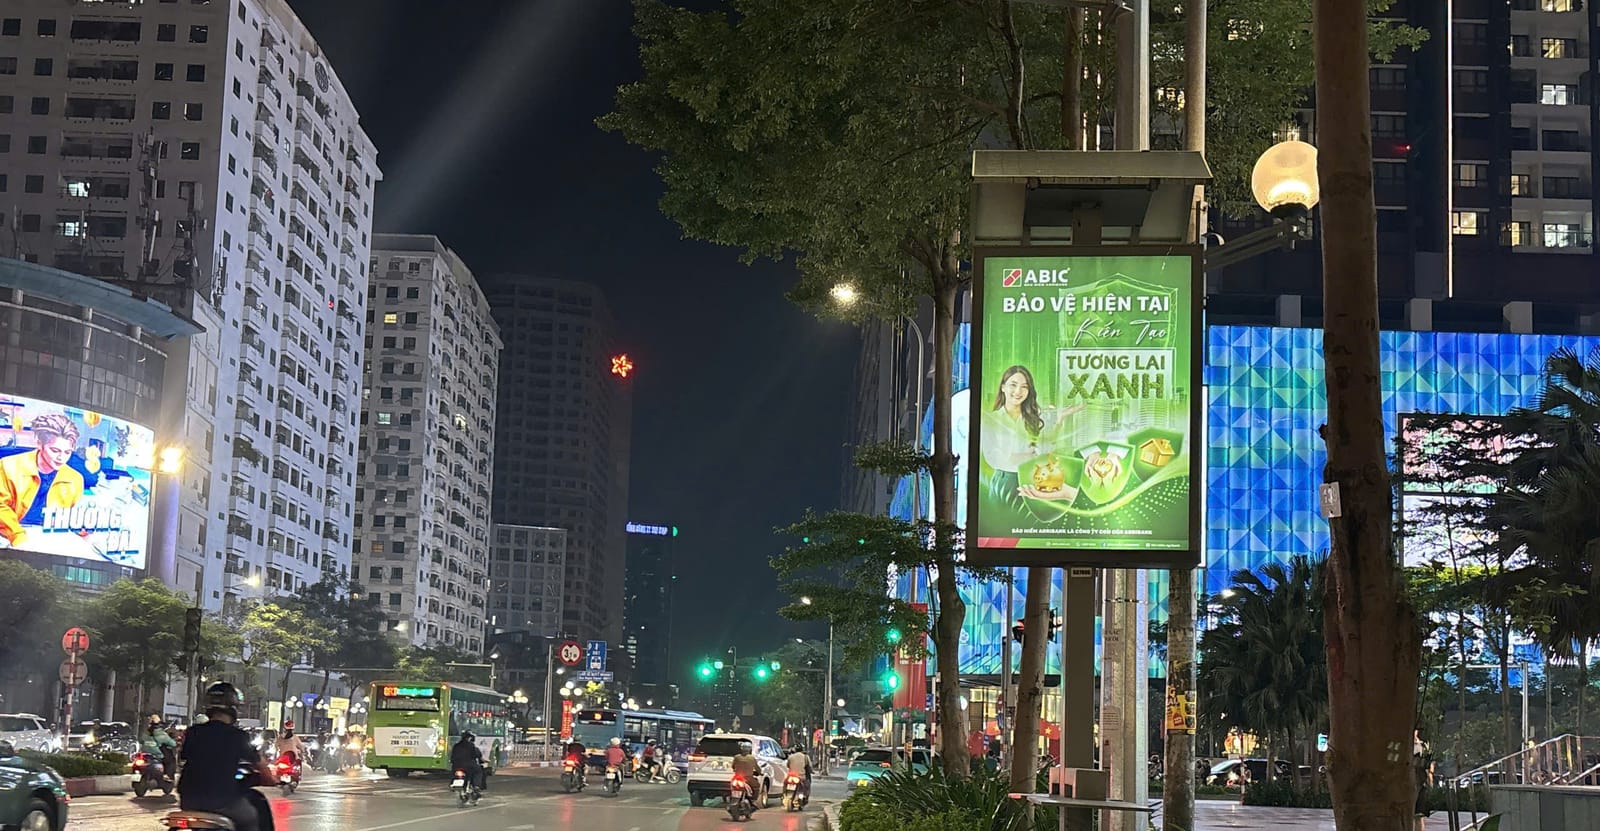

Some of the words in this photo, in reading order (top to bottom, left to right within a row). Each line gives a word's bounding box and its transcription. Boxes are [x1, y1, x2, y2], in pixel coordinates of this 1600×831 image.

[1024, 269, 1069, 283] ABIC
[1003, 293, 1044, 312] BẢO
[1050, 293, 1077, 316] VỆ
[1082, 293, 1131, 315] HIỆN
[1137, 296, 1169, 315] TẠI
[1073, 317, 1122, 346] Kiến
[1129, 319, 1169, 345] Tạo
[1066, 353, 1130, 370] TƯƠNG
[1135, 355, 1166, 370] LAI
[1067, 372, 1165, 399] XANH
